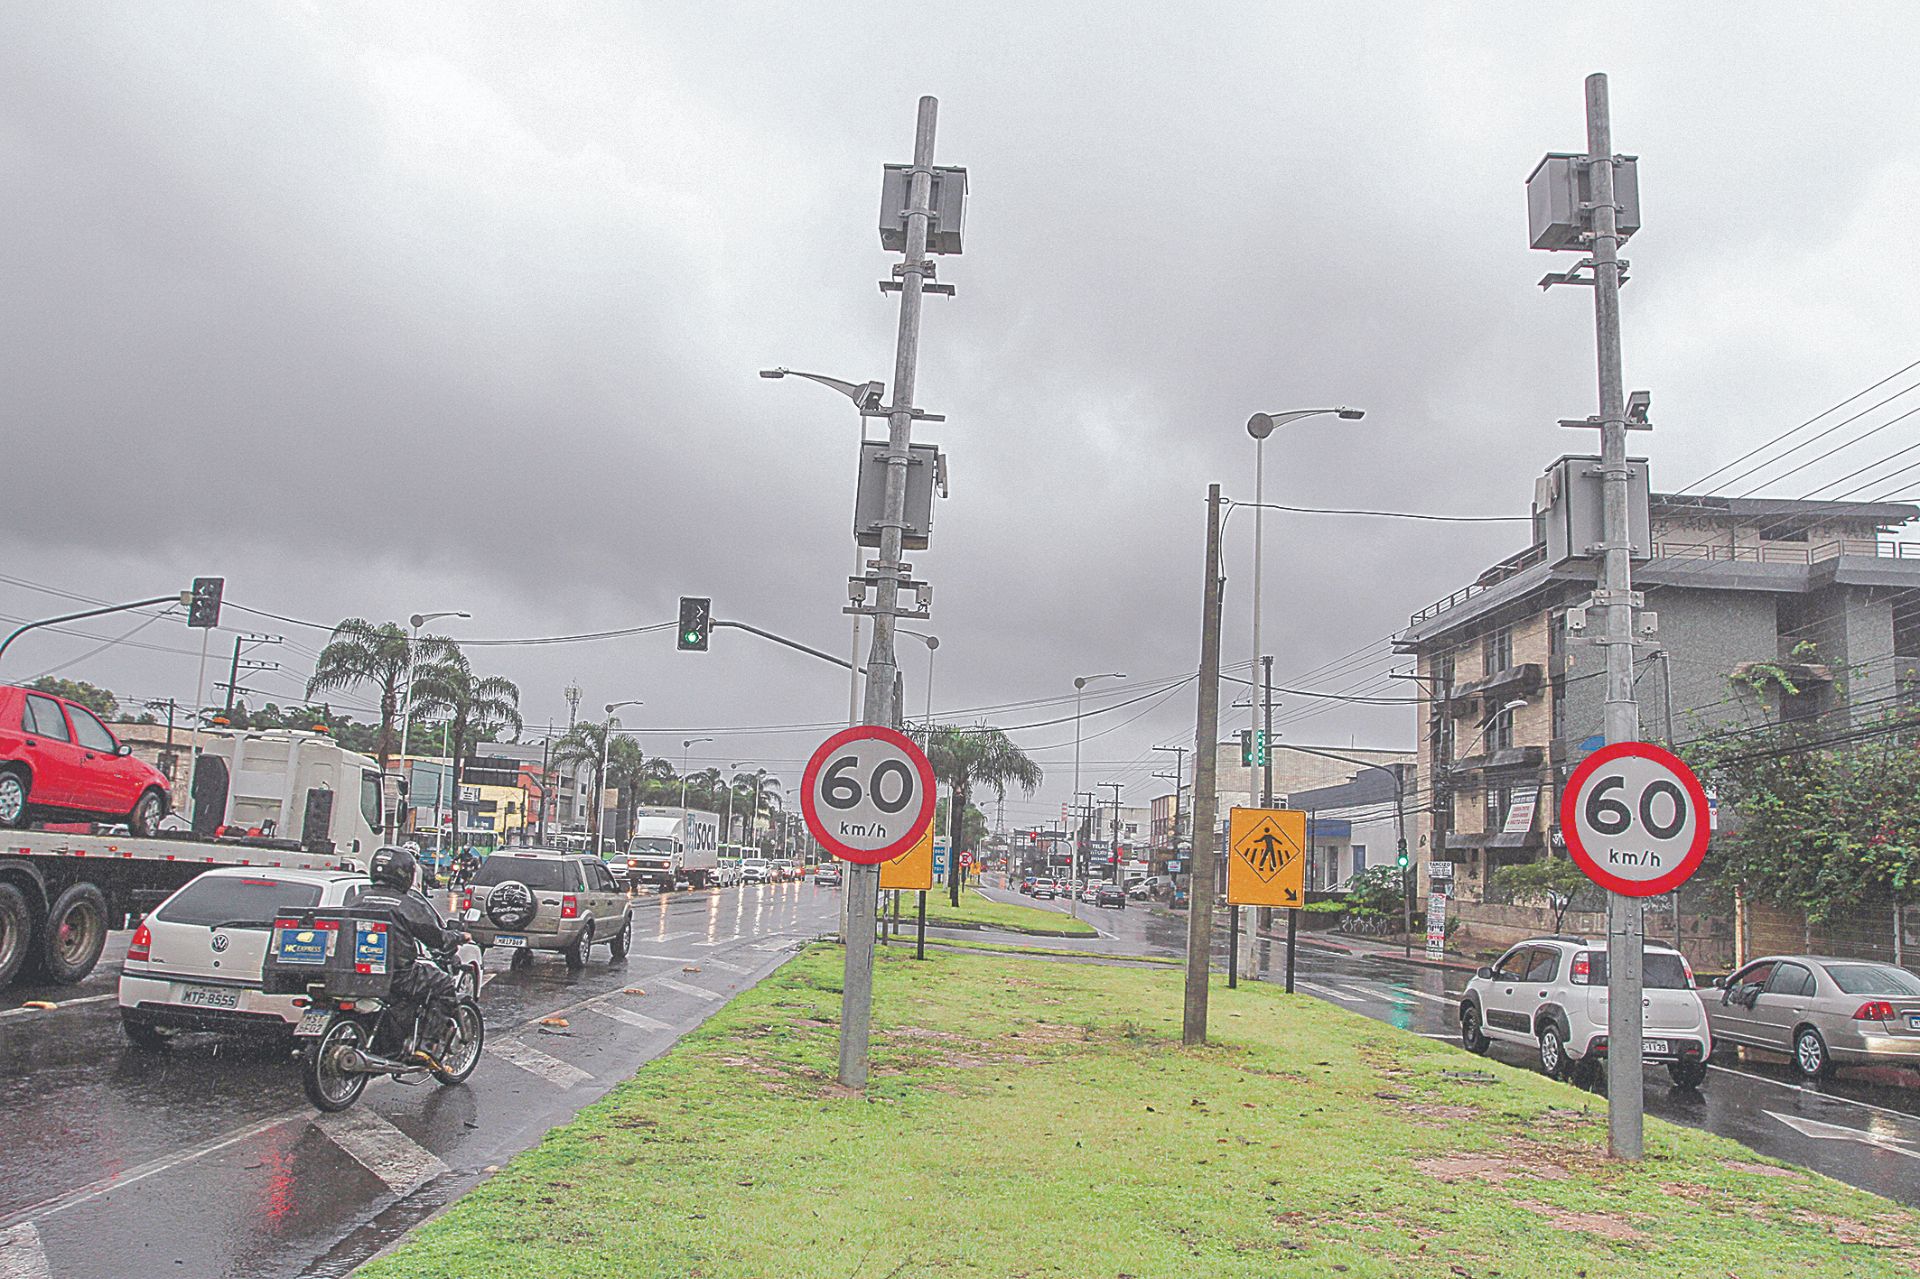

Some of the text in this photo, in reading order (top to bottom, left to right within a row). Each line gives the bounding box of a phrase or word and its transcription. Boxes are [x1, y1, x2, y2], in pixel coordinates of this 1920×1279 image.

[821, 756, 914, 814] 60
[1585, 775, 1687, 840] 60
[839, 821, 887, 839] km/h
[1609, 848, 1662, 867] km/h
